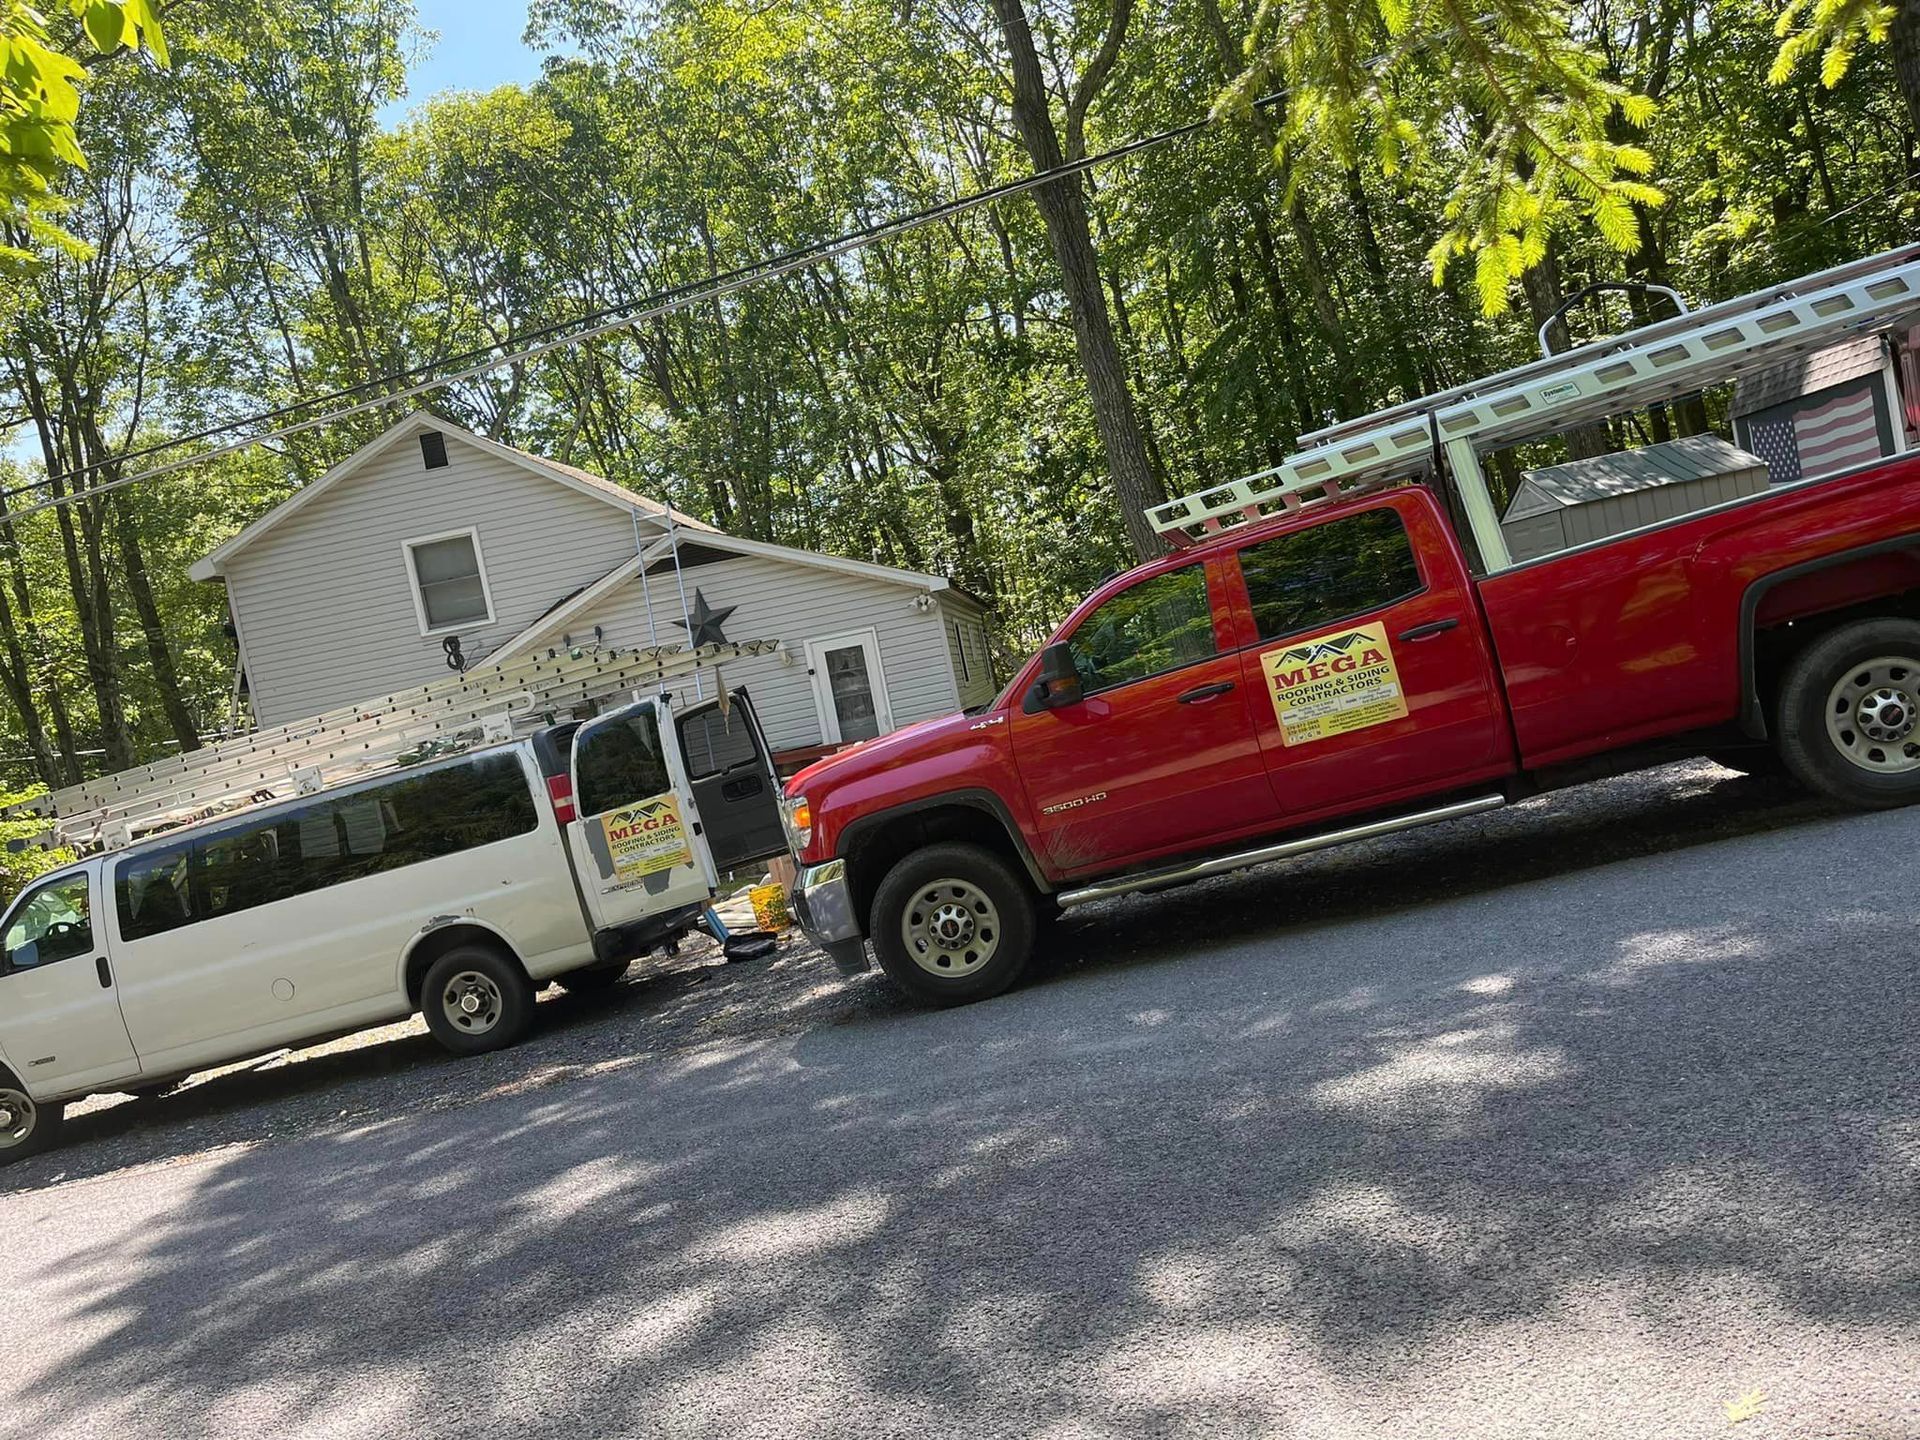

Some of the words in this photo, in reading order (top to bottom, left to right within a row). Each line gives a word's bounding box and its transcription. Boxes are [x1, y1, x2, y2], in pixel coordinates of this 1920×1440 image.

[1272, 648, 1387, 690] MEGA
[1277, 681, 1333, 702] ROOFING
[1335, 678, 1344, 687] &
[1347, 666, 1390, 683] SIDING
[1289, 676, 1382, 707] CONTRACTORS
[1043, 798, 1083, 815] 3500
[1085, 791, 1107, 804] HD
[609, 814, 678, 841] MEGA
[612, 836, 645, 850] ROOFING
[653, 825, 680, 838] SIDING
[619, 833, 676, 854] CONTRACTORS
